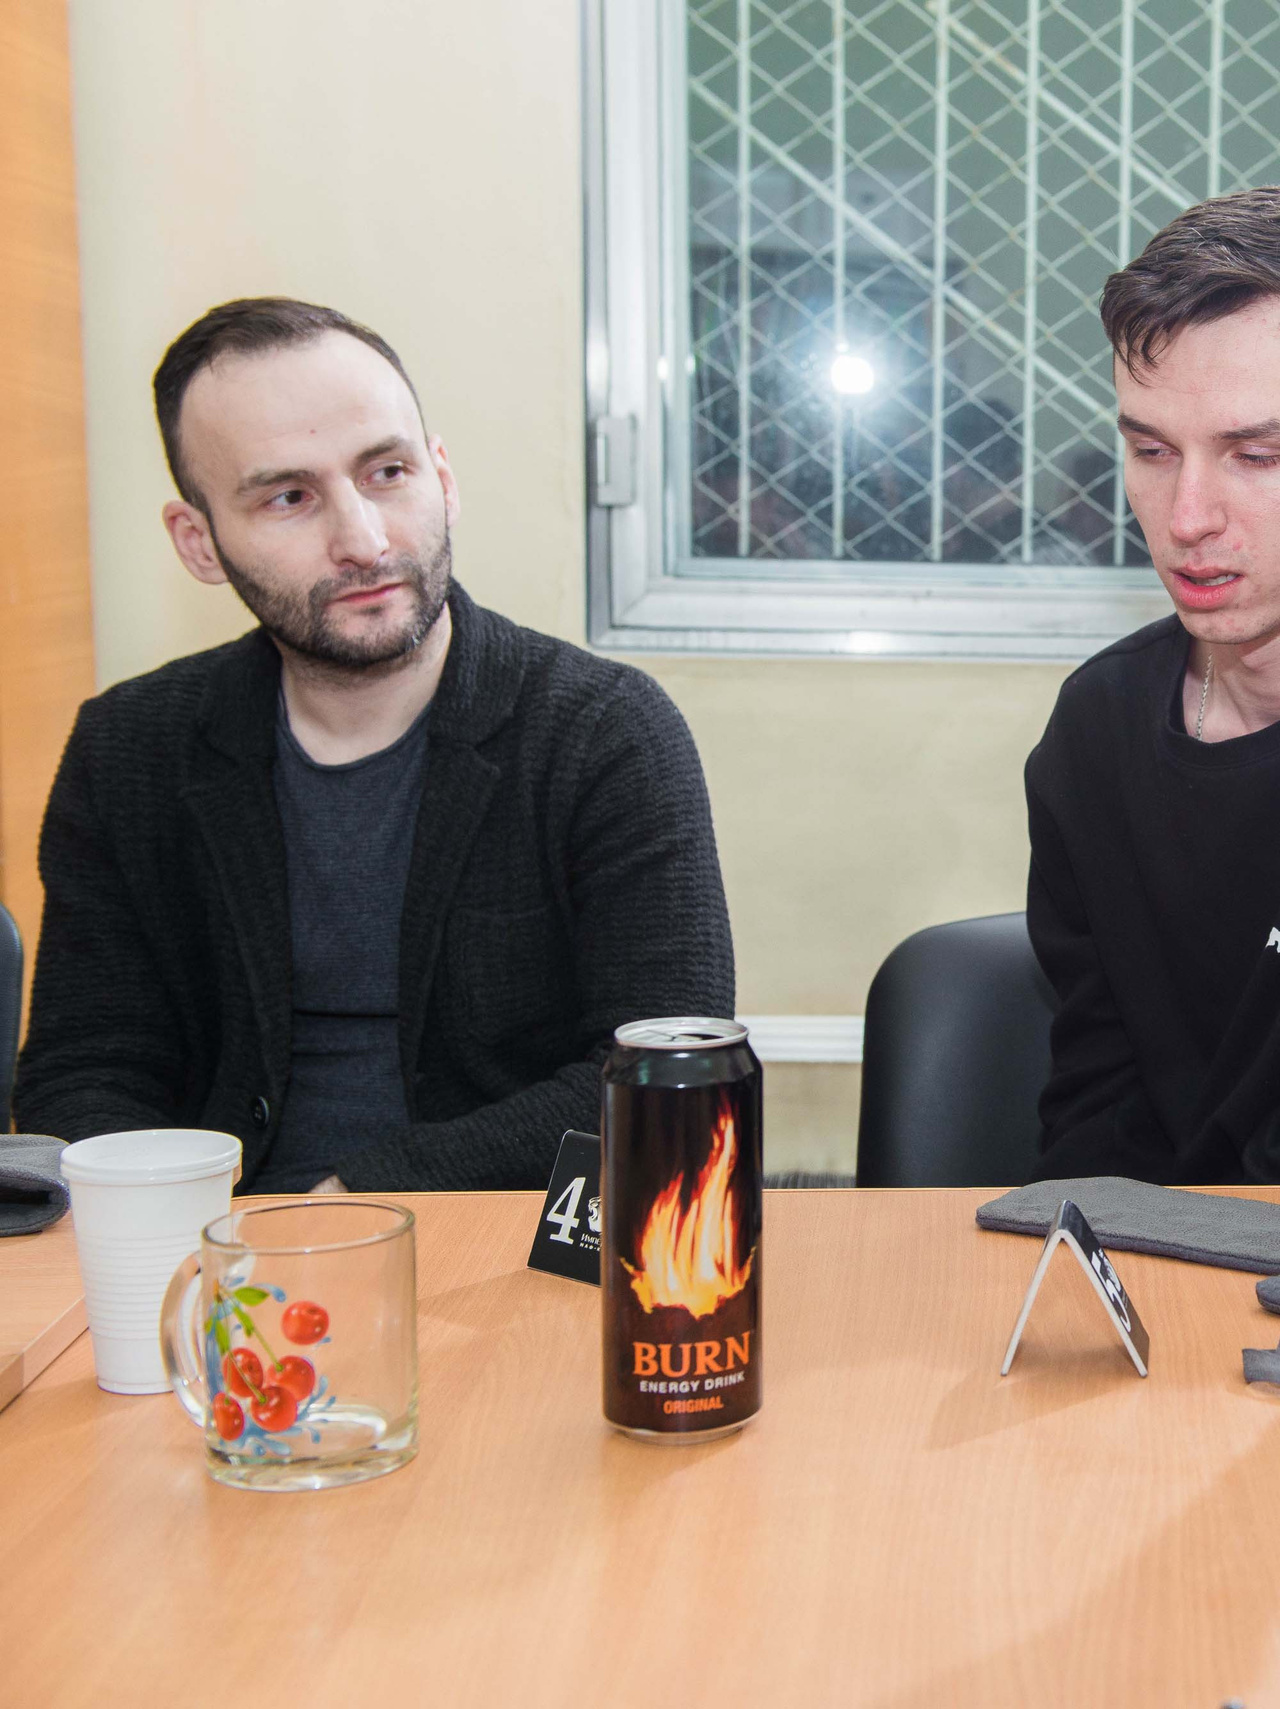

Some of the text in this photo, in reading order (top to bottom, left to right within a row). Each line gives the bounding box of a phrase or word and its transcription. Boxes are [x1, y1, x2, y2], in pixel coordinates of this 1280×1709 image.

[546, 1177, 587, 1246] 4
[633, 1332, 751, 1378] BURN
[639, 1371, 746, 1394] ENERGY DRINK
[663, 1396, 724, 1415] ORIGINAL
